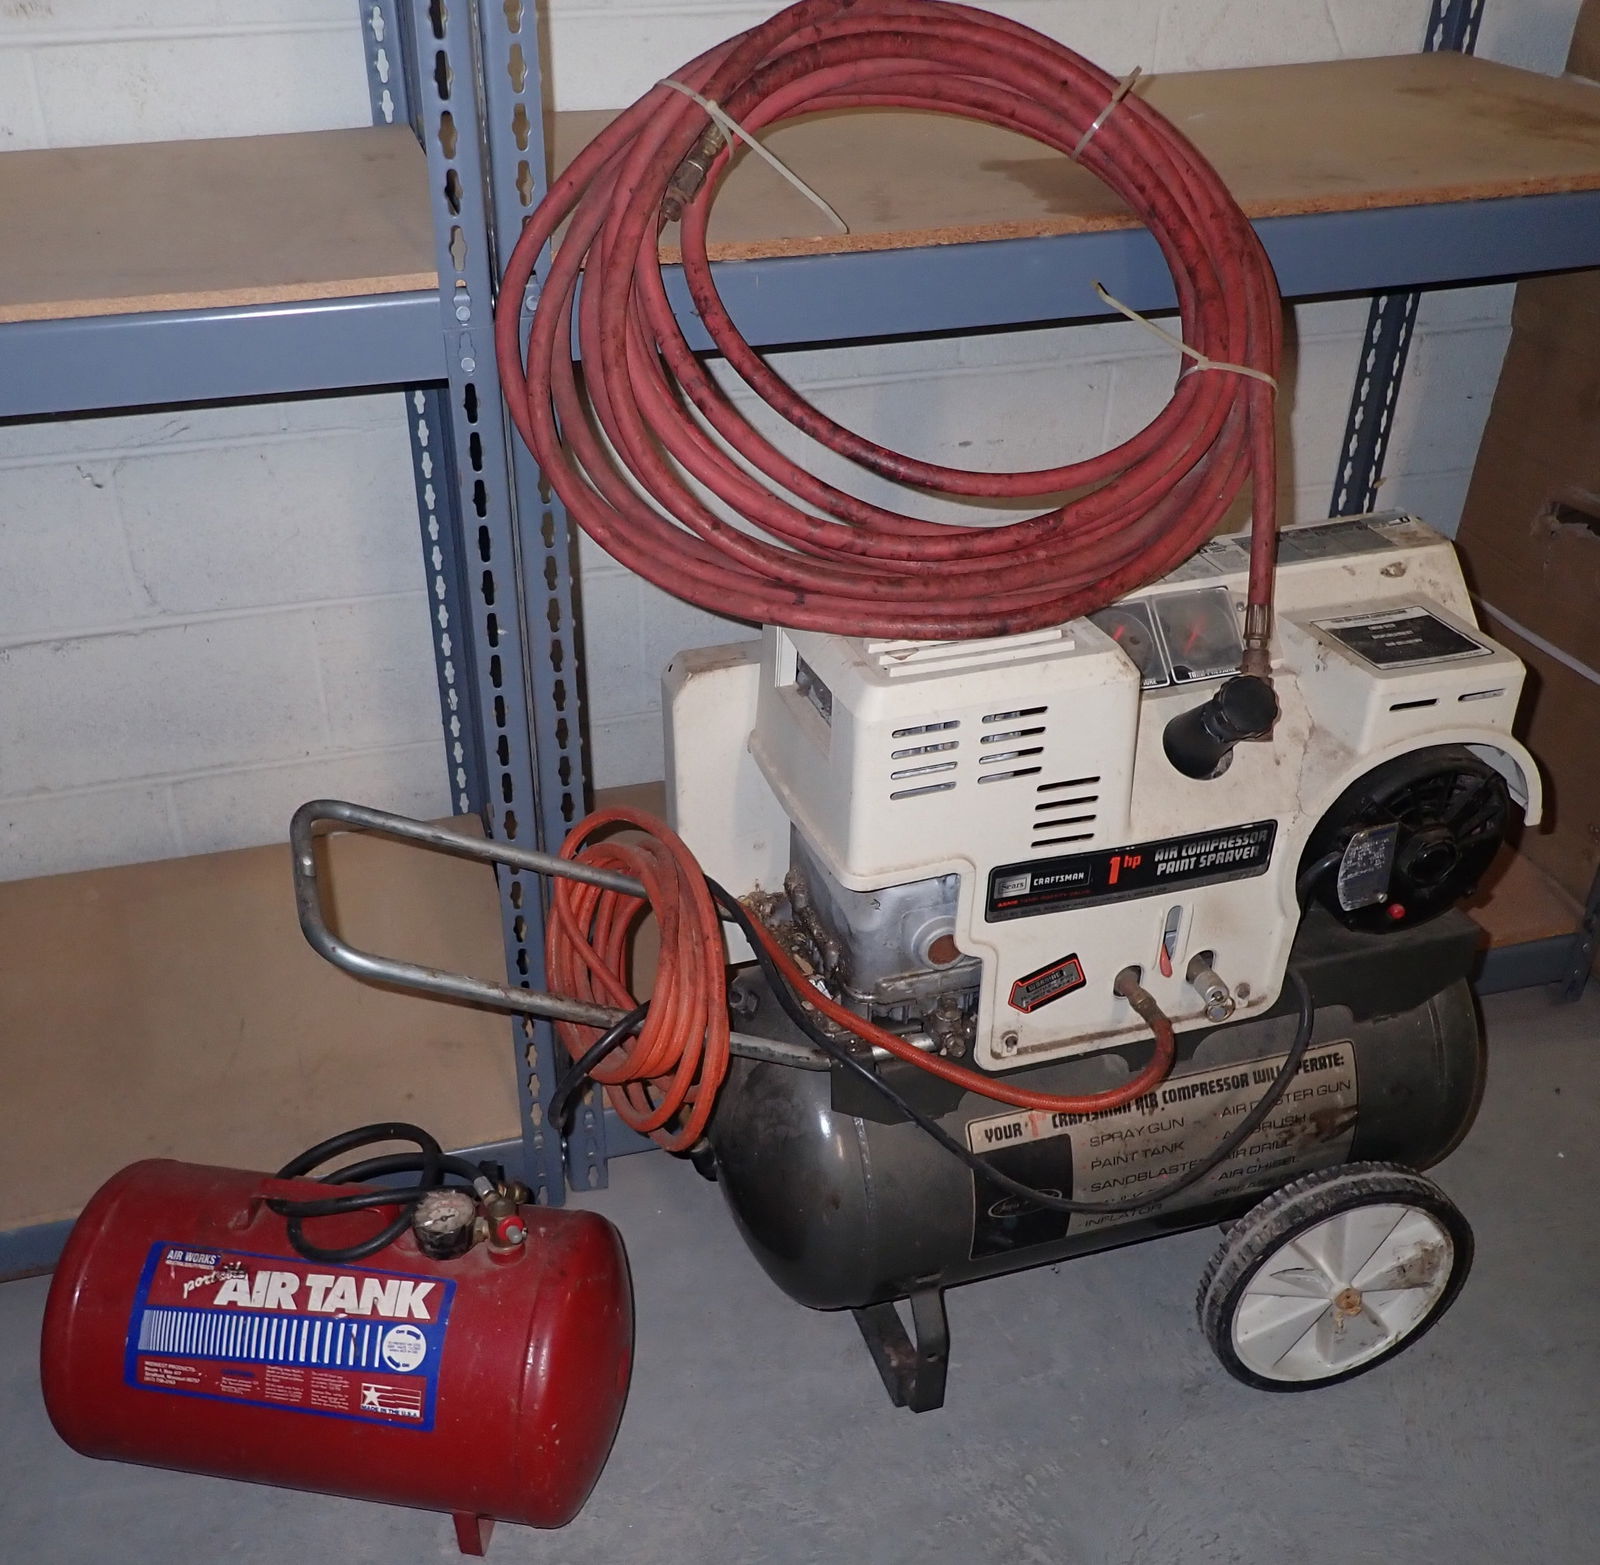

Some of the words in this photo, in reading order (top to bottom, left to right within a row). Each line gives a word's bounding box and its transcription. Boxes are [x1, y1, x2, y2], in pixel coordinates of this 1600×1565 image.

[1154, 846, 1178, 862] AIR
[1181, 829, 1268, 857] COMPRESSOR
[1156, 857, 1197, 876] PAINT
[1198, 845, 1260, 868] SPRAYER
[1001, 880, 1025, 890] Sears
[1033, 872, 1085, 886] CRAFTSMAN
[984, 1122, 1023, 1143] YOUR
[1162, 1072, 1250, 1105] COMPRESSOR
[1222, 1103, 1247, 1118] AIR
[1317, 1079, 1351, 1097] GUN
[1090, 1125, 1145, 1148] SPRAY
[1148, 1117, 1185, 1134] GUN
[1091, 1151, 1139, 1171] PAINT
[1142, 1141, 1185, 1158] TANK
[1250, 1139, 1293, 1157] DRILL
[1218, 1168, 1243, 1181] AIR
[1246, 1155, 1297, 1175] CHISEL
[167, 1250, 182, 1261] AIR
[185, 1252, 217, 1265] WORKS
[213, 1270, 300, 1310] AIR
[305, 1273, 436, 1319] TANK
